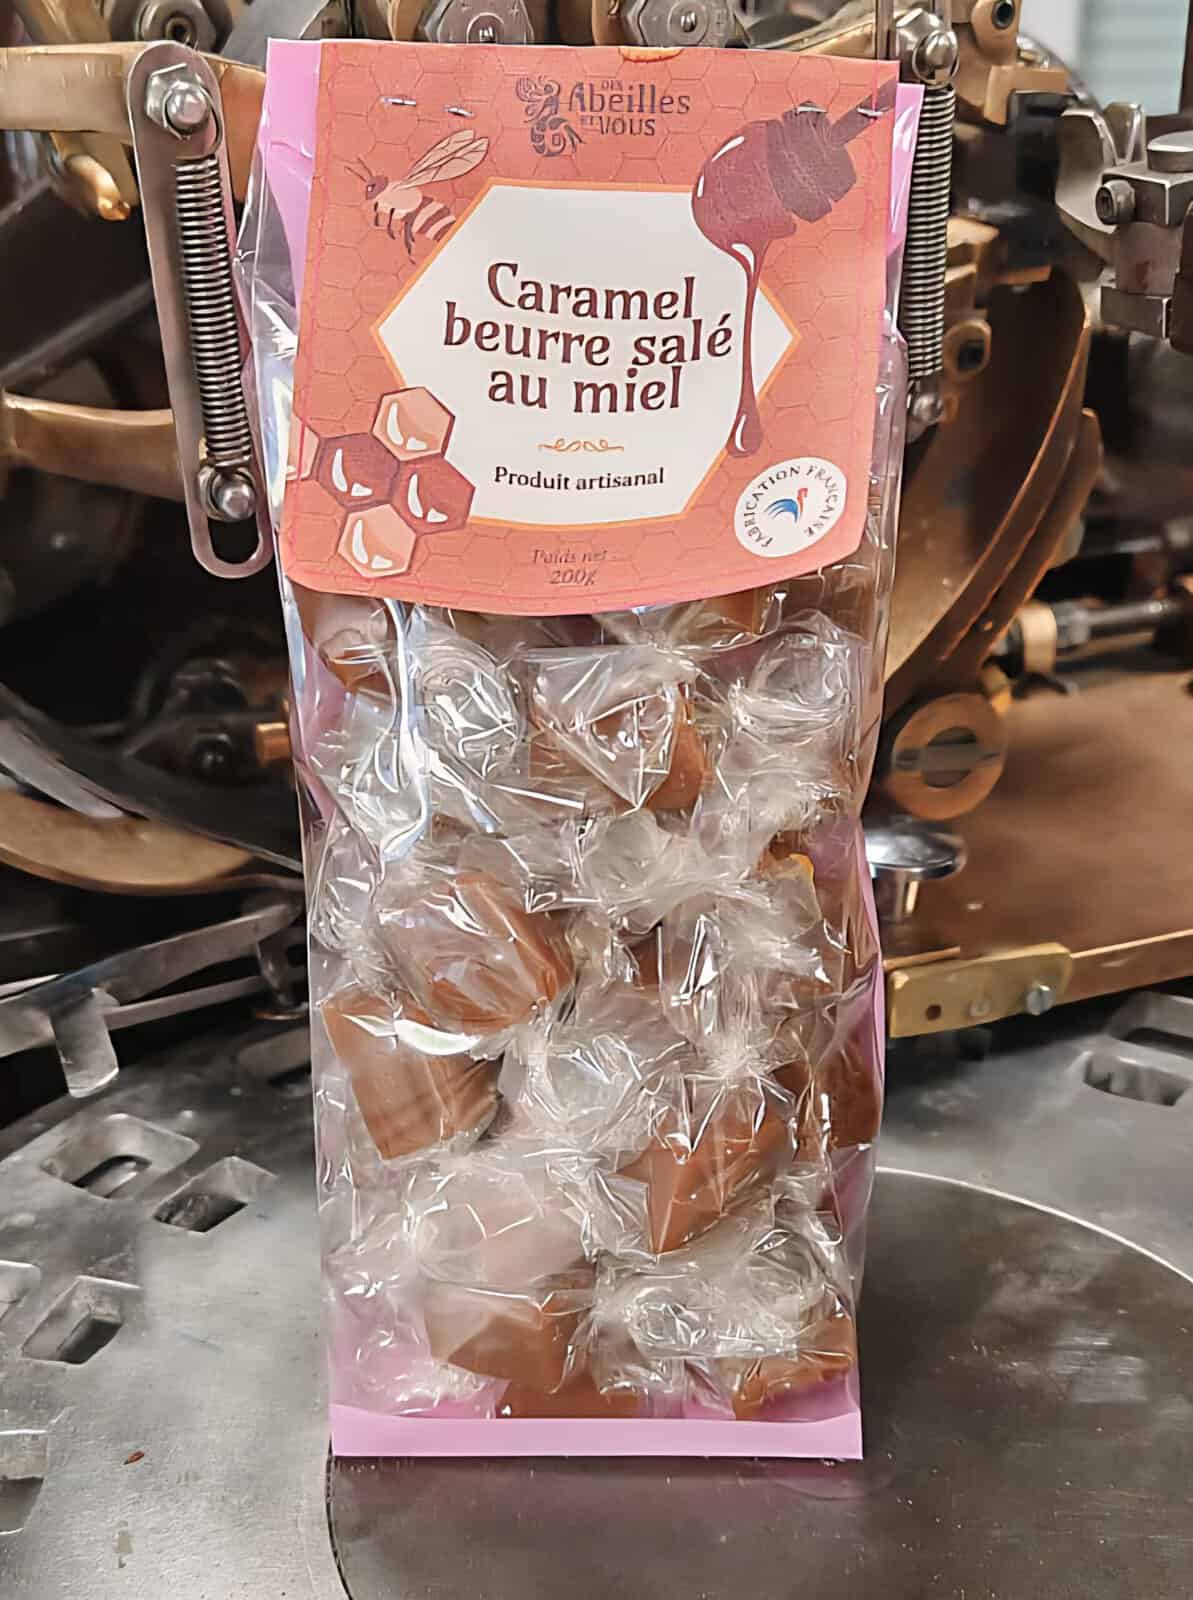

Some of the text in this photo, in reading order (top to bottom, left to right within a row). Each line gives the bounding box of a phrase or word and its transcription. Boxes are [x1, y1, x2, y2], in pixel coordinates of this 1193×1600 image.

[568, 81, 691, 114] Abeilles
[600, 115, 656, 136] VOUS
[487, 262, 695, 320] Caramel
[443, 301, 733, 366] beurre salé
[488, 366, 682, 413] au miel
[494, 466, 664, 490] Produit artisanal
